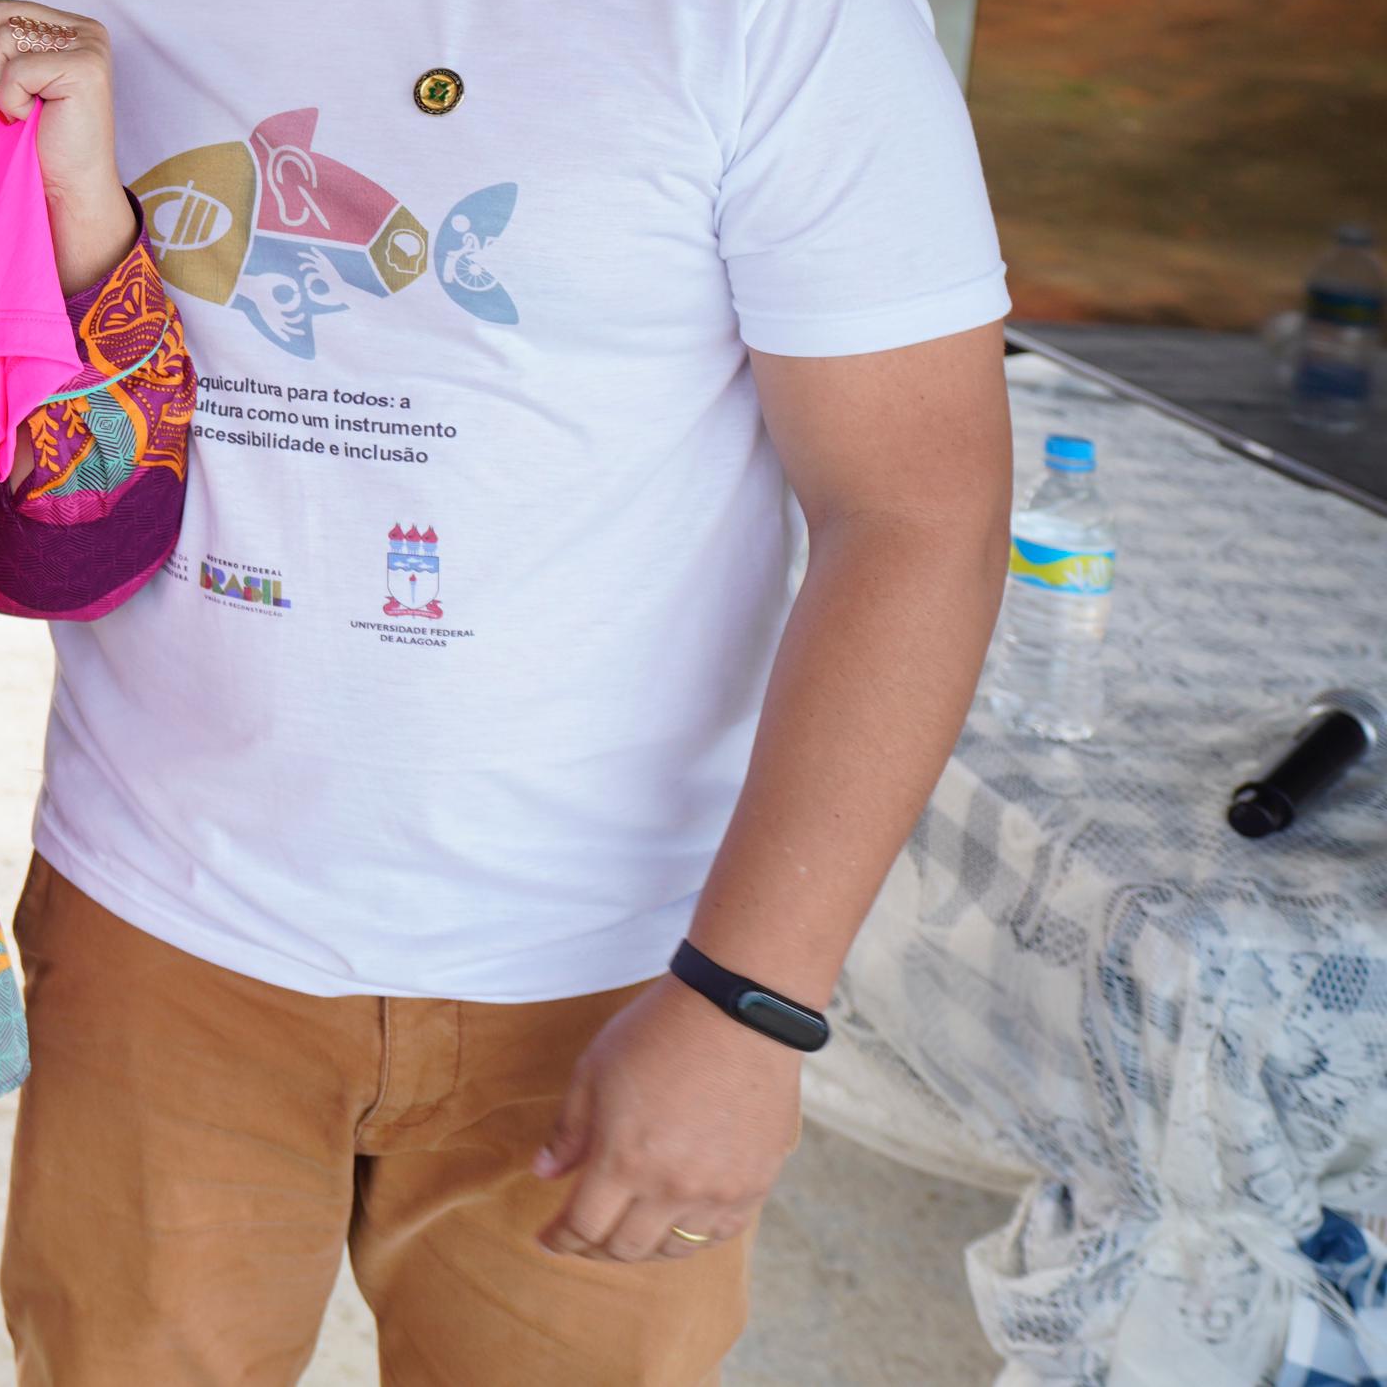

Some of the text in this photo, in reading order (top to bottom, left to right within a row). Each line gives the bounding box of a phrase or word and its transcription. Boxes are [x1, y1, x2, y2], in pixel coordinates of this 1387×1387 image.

[197, 375, 411, 410] quicultura para todos: a
[195, 399, 457, 439] ultura como um instrumento
[194, 424, 429, 464] acessibilidade e inclusão
[199, 561, 292, 609] BRASIL
[242, 564, 283, 577] FEDERAL
[350, 620, 475, 637] UNIVERSIDADE FEDERAL
[380, 634, 448, 648] DE ALAGOAS
